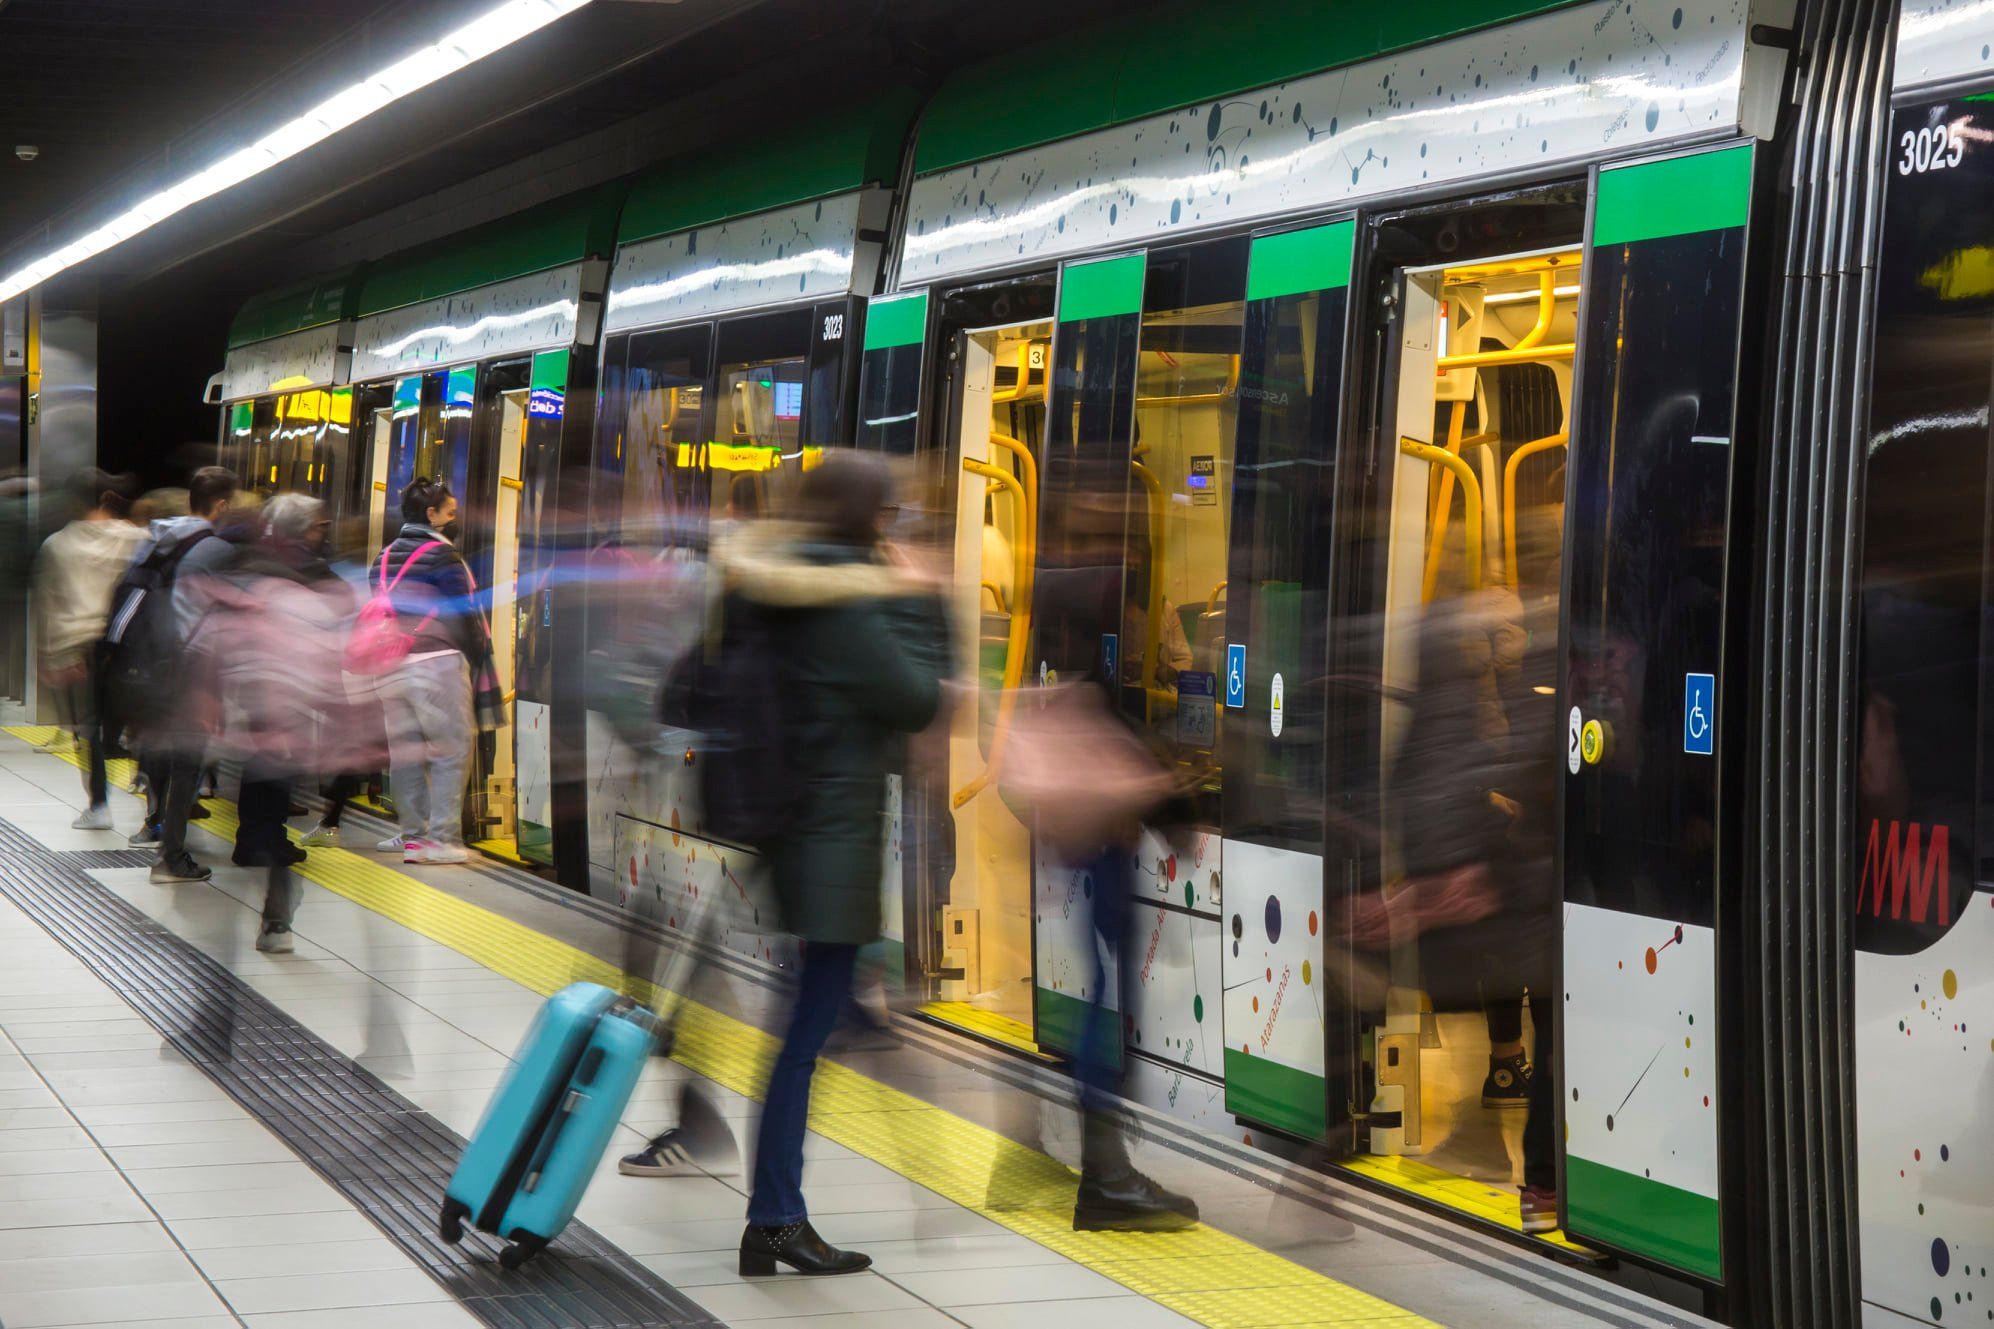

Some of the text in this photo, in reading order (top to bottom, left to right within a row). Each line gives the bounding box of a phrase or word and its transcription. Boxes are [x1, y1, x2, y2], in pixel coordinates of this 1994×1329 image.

[1899, 124, 1964, 176] 3025
[823, 314, 844, 341] 3023
[1140, 928, 1160, 987] Portada
[1259, 964, 1291, 1054] Atarazanas
